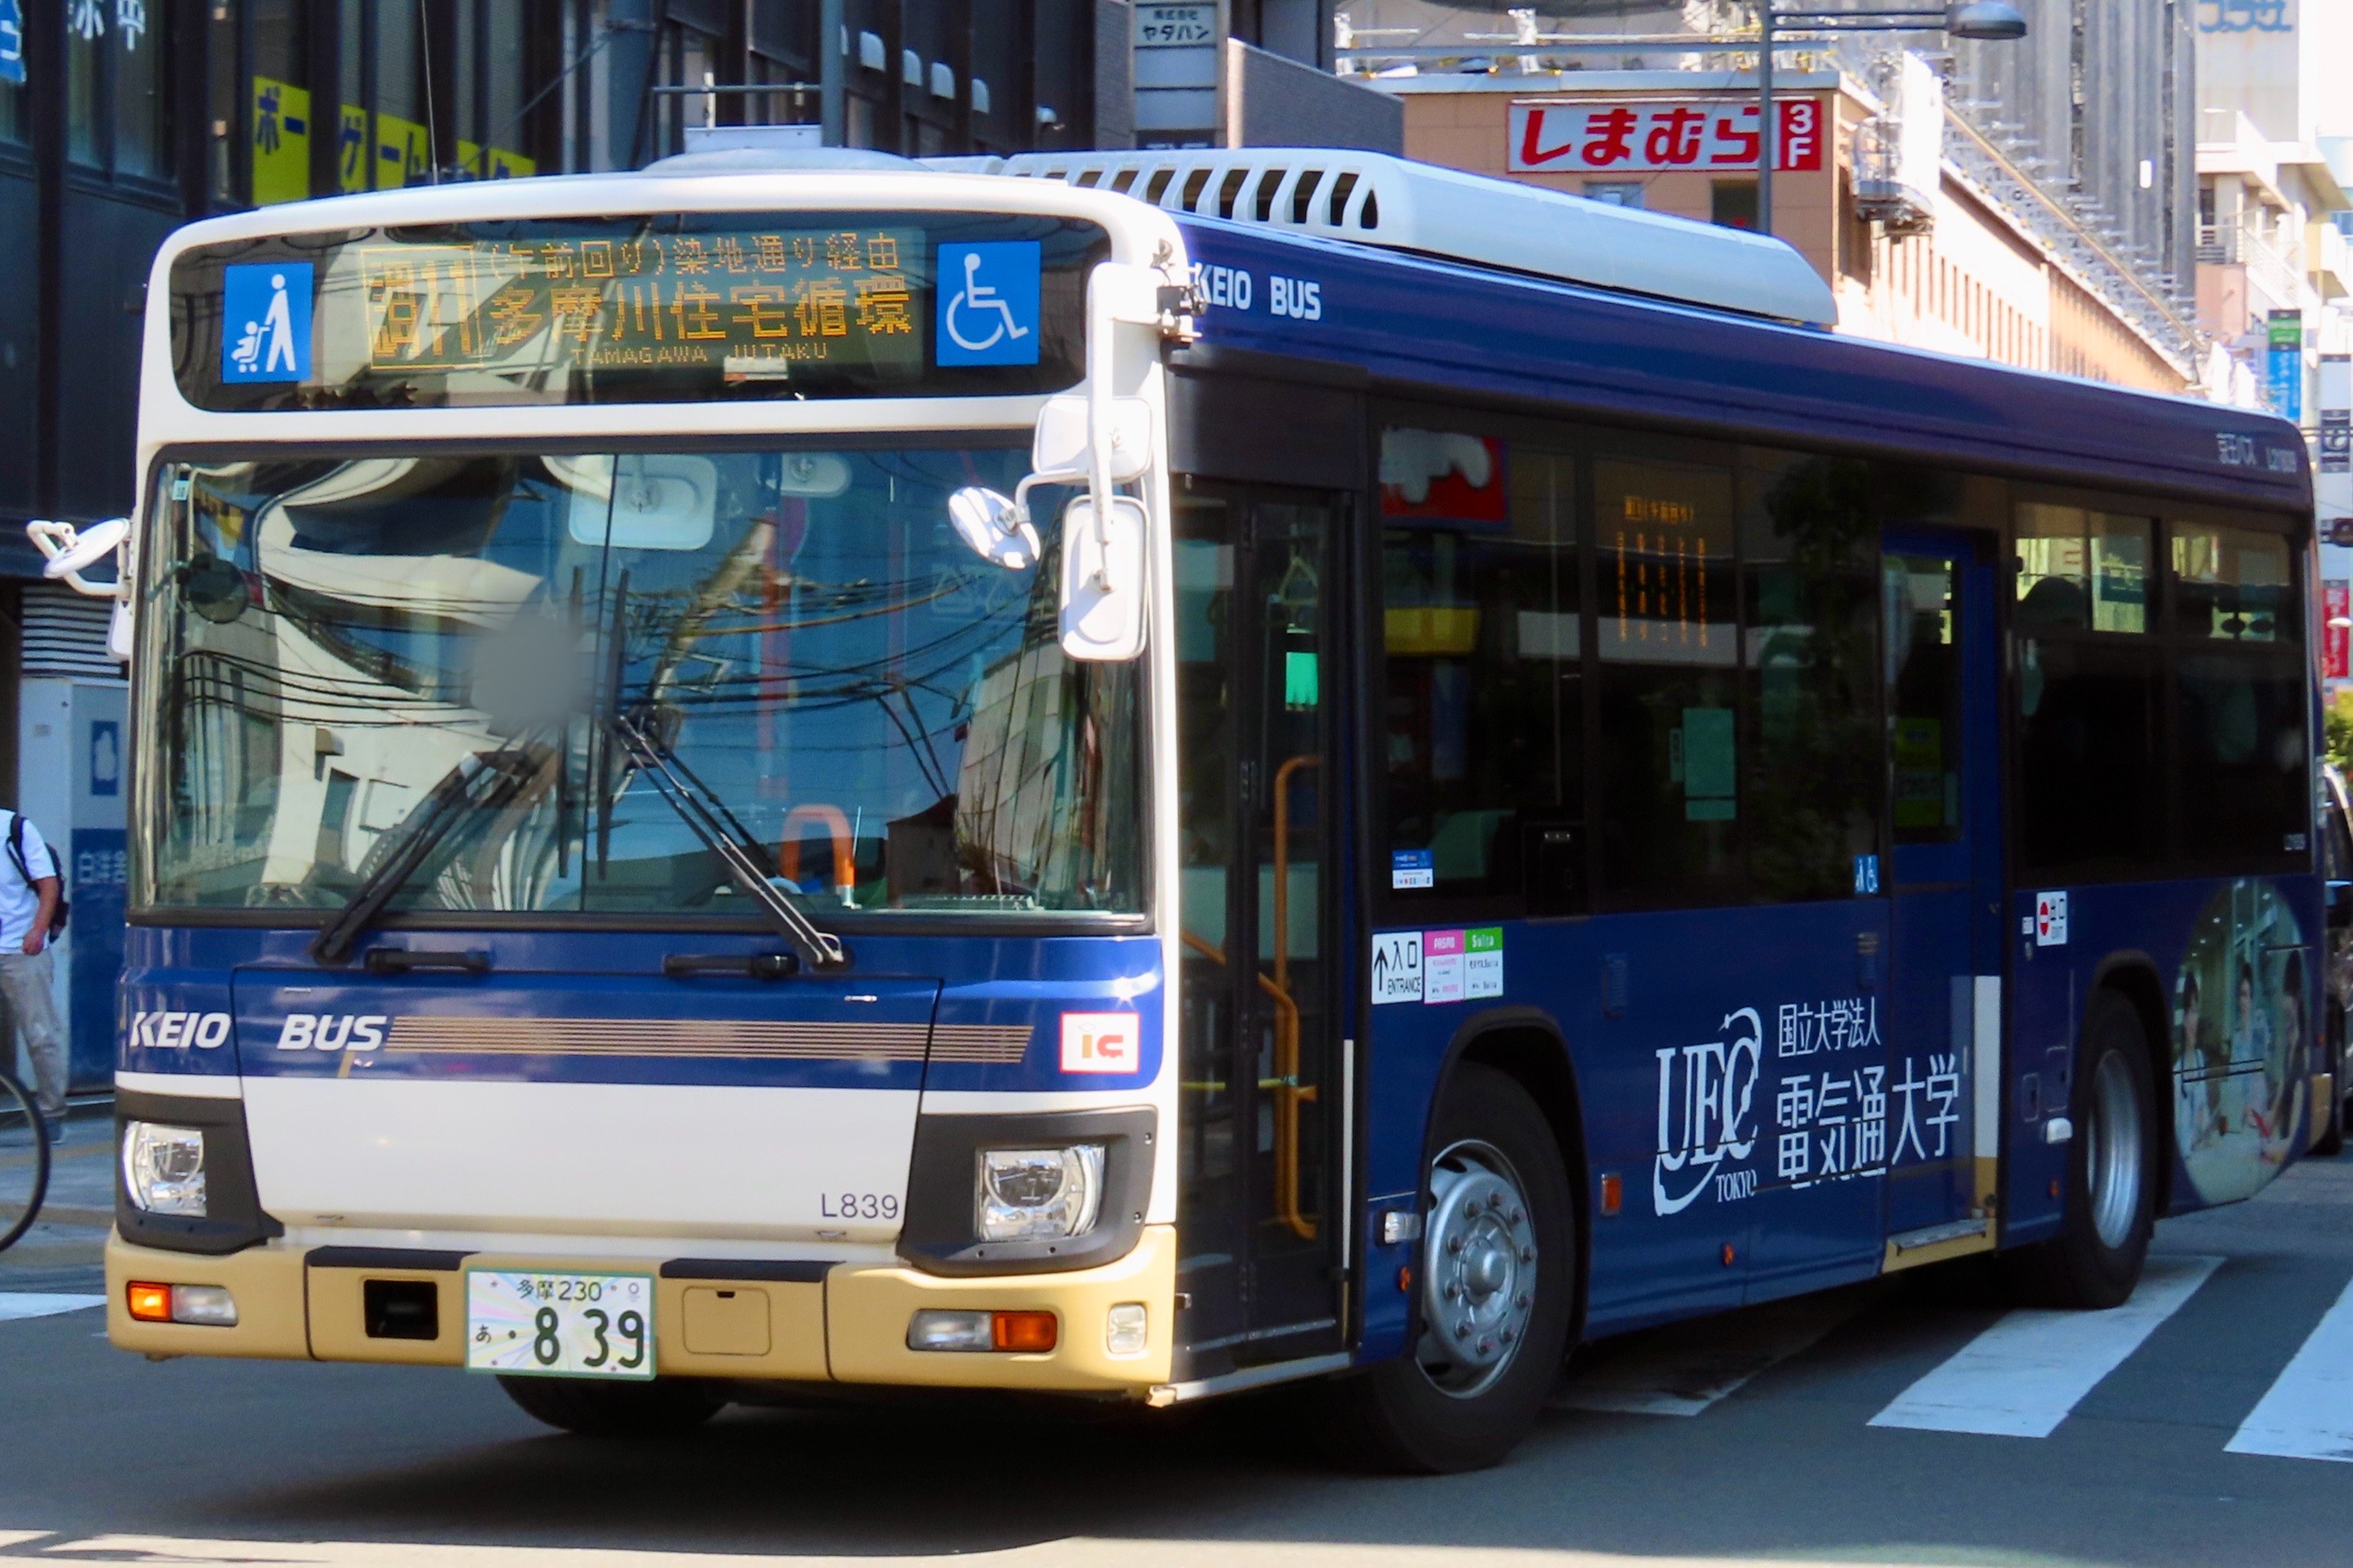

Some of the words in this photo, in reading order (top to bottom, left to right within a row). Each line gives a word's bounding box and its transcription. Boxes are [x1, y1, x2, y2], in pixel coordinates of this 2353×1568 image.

[1520, 107, 1761, 166] しまむら
[1788, 104, 1814, 168] 3F
[490, 275, 912, 345] 多摩川住宅循環
[1195, 262, 1252, 310] KEIO
[1270, 276, 1321, 321] BUS
[570, 347, 709, 368] TAMAGAWA
[729, 342, 828, 361] JUTAKU
[1392, 940, 1418, 971] 入口
[1387, 977, 1421, 995] ENTRANCE
[129, 1012, 232, 1049] KEIO
[276, 1013, 388, 1051] BUS
[1778, 996, 1881, 1057] 国立大学法人
[1654, 1031, 1761, 1175] UEC
[1716, 1168, 1758, 1203] TOKYO
[821, 1193, 898, 1219] L839
[475, 1324, 492, 1343] あ
